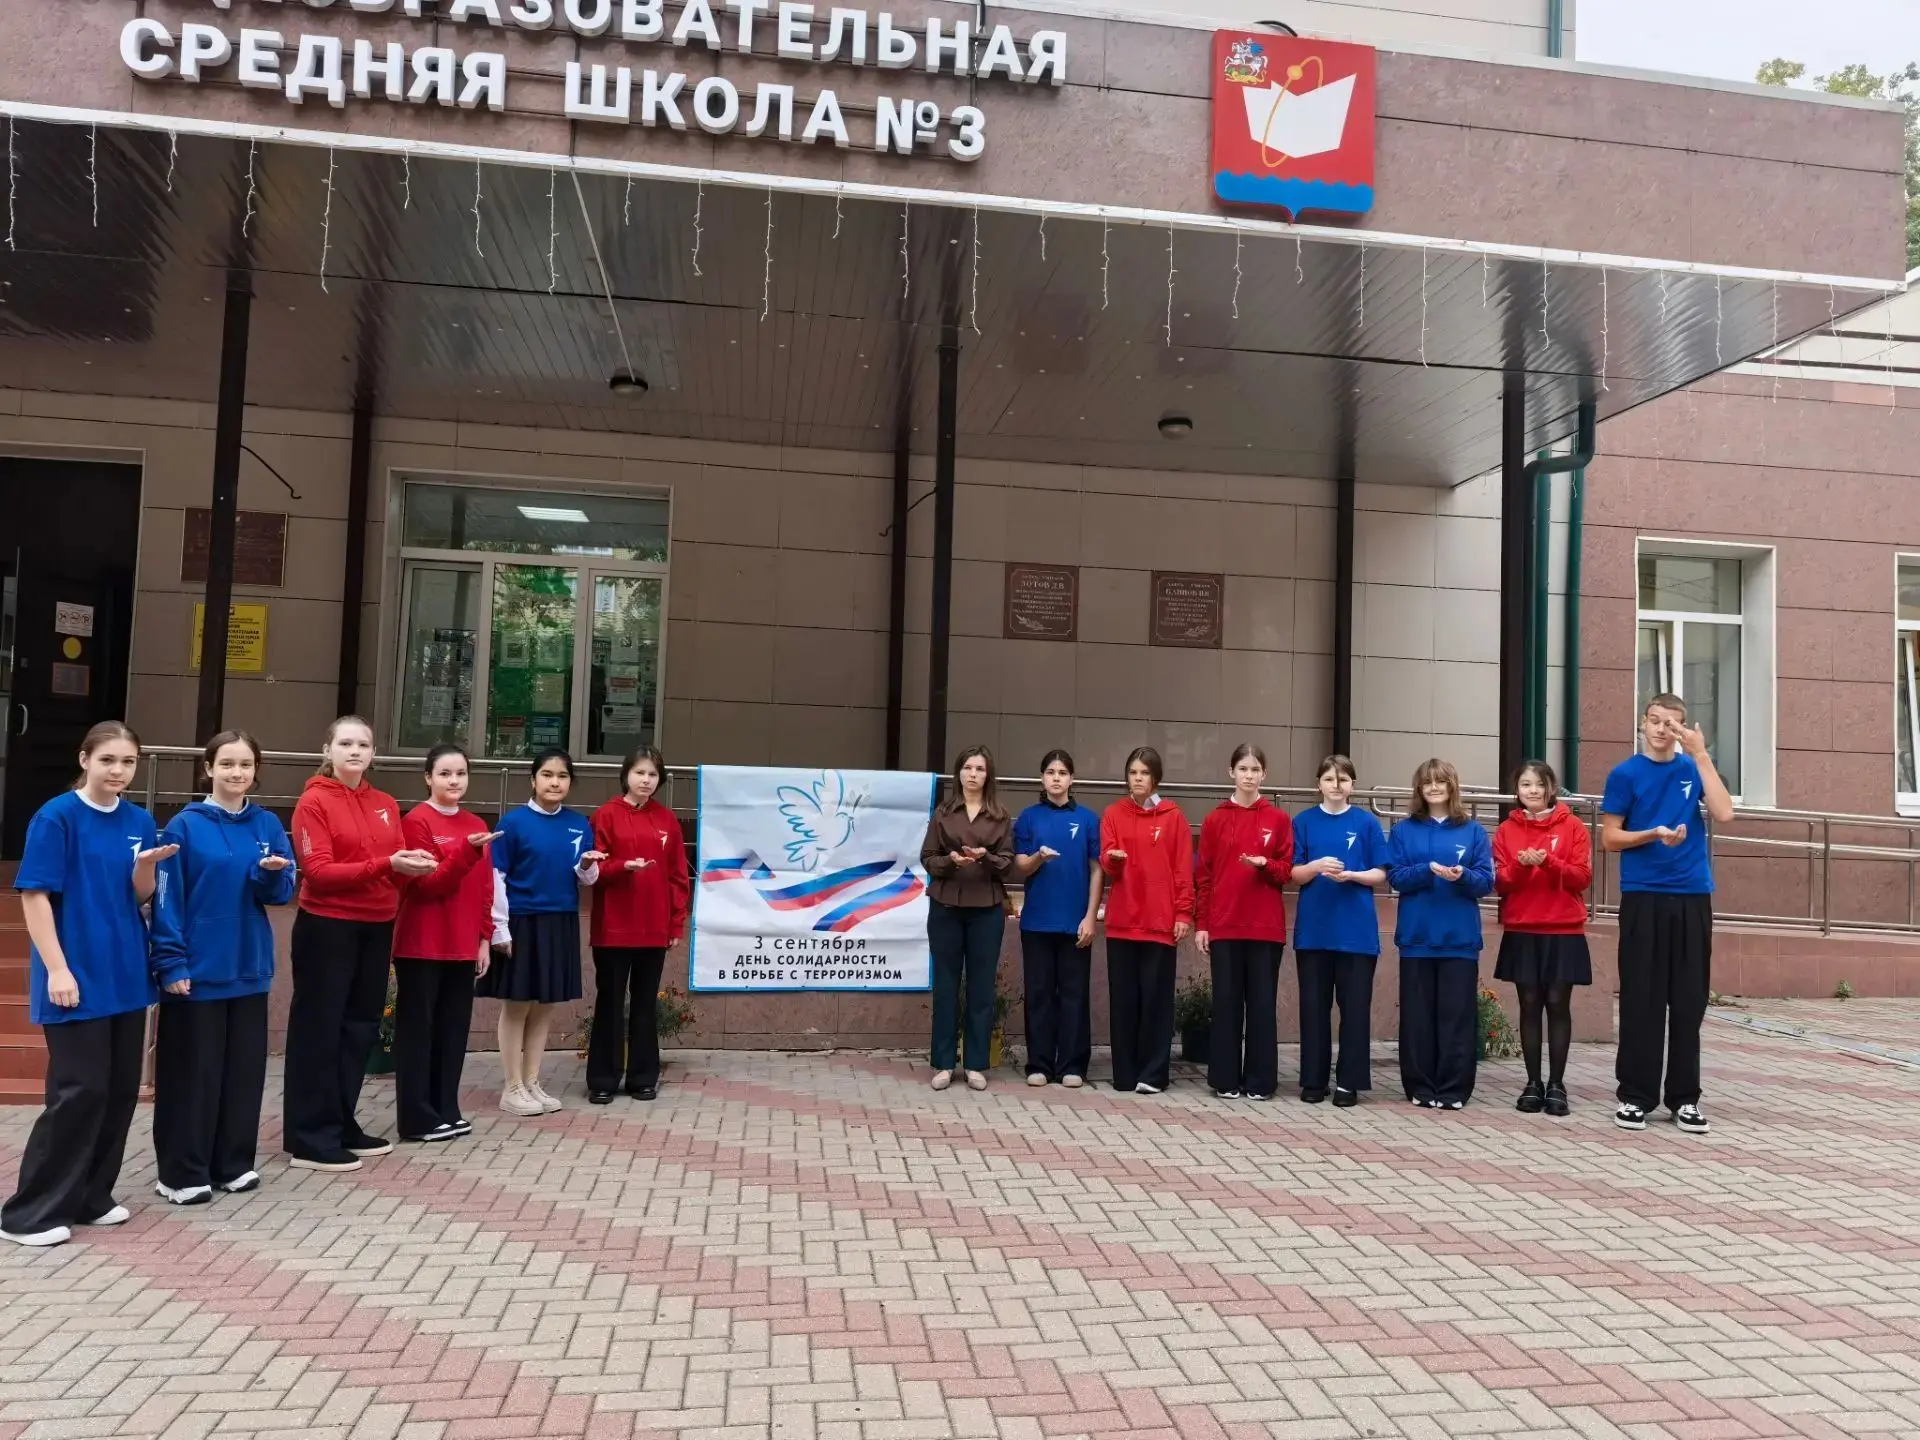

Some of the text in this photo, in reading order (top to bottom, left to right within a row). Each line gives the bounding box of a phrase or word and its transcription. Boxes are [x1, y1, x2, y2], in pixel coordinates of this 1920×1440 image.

[119, 17, 507, 113] СРЕДНЯЯ
[564, 60, 851, 148] ШКОЛА
[754, 936, 866, 953] 3 сентября
[735, 955, 887, 967] ДЕНЬ СОЛИДАРНОСТИ
[718, 969, 903, 980] В БОРЬБЕ С ТЕРРОРИЗМОМ
